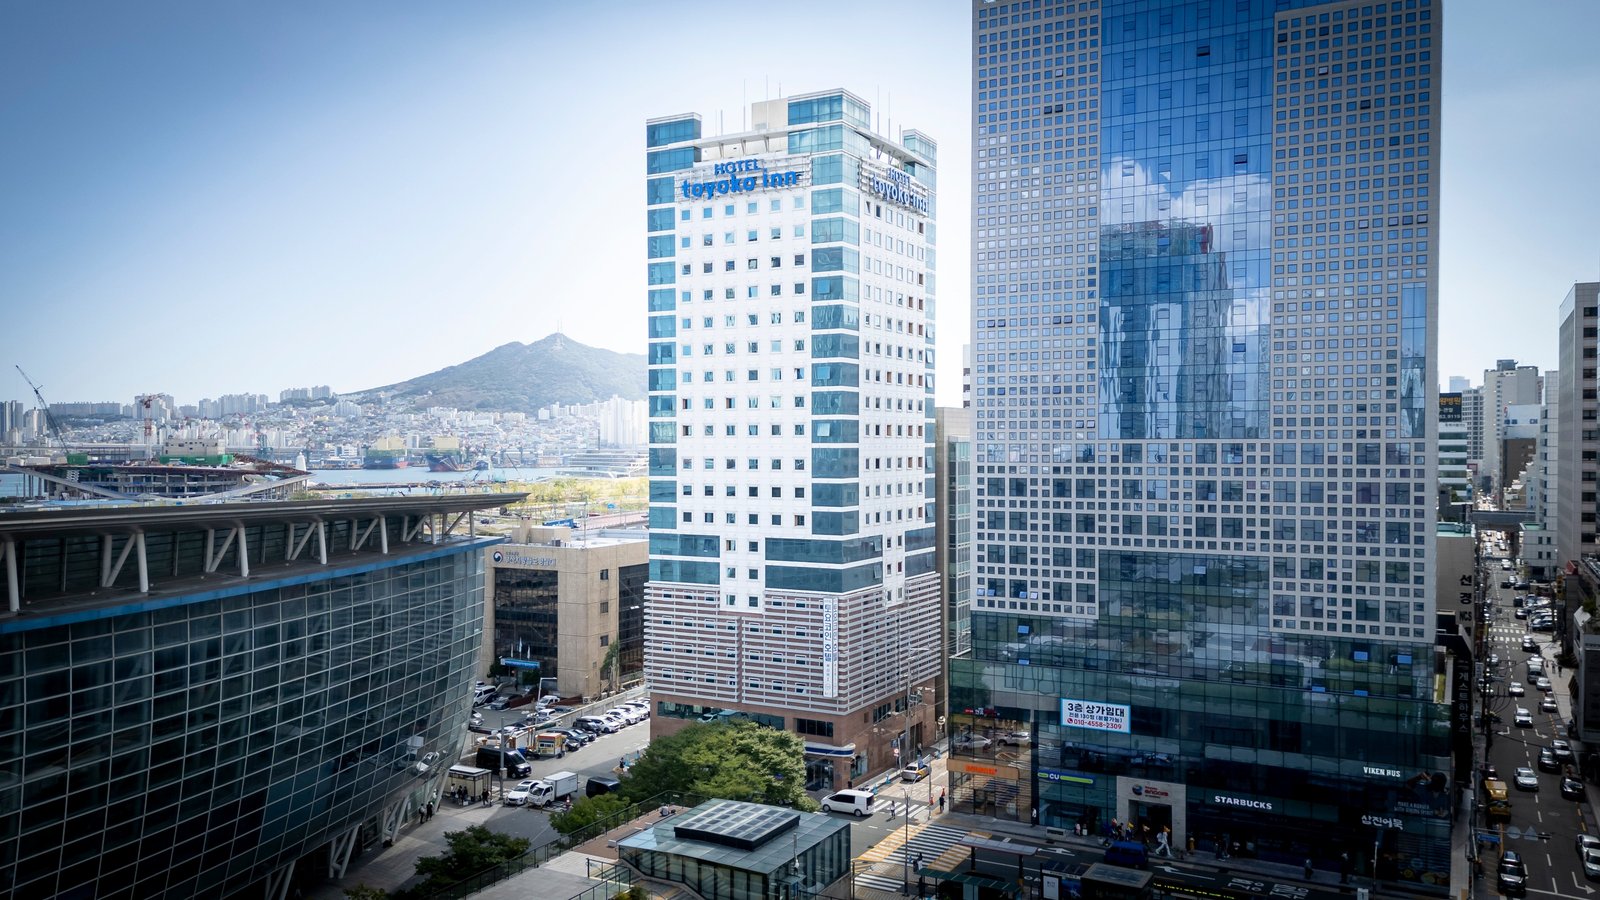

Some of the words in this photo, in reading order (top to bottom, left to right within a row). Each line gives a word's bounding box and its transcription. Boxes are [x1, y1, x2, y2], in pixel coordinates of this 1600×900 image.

[714, 158, 761, 176] HOTEL
[681, 175, 756, 200] toyoko
[762, 168, 798, 188] inn
[872, 173, 910, 206] toyoko
[1067, 702, 1083, 713] 3층
[1085, 704, 1125, 717] 상가임대
[1458, 671, 1469, 733] 게스트하우스
[1073, 719, 1122, 730] 010-4558-2309
[1049, 773, 1060, 781] CU
[1214, 795, 1272, 810] STARBUCKS
[1361, 814, 1403, 831] 삼진어묵
